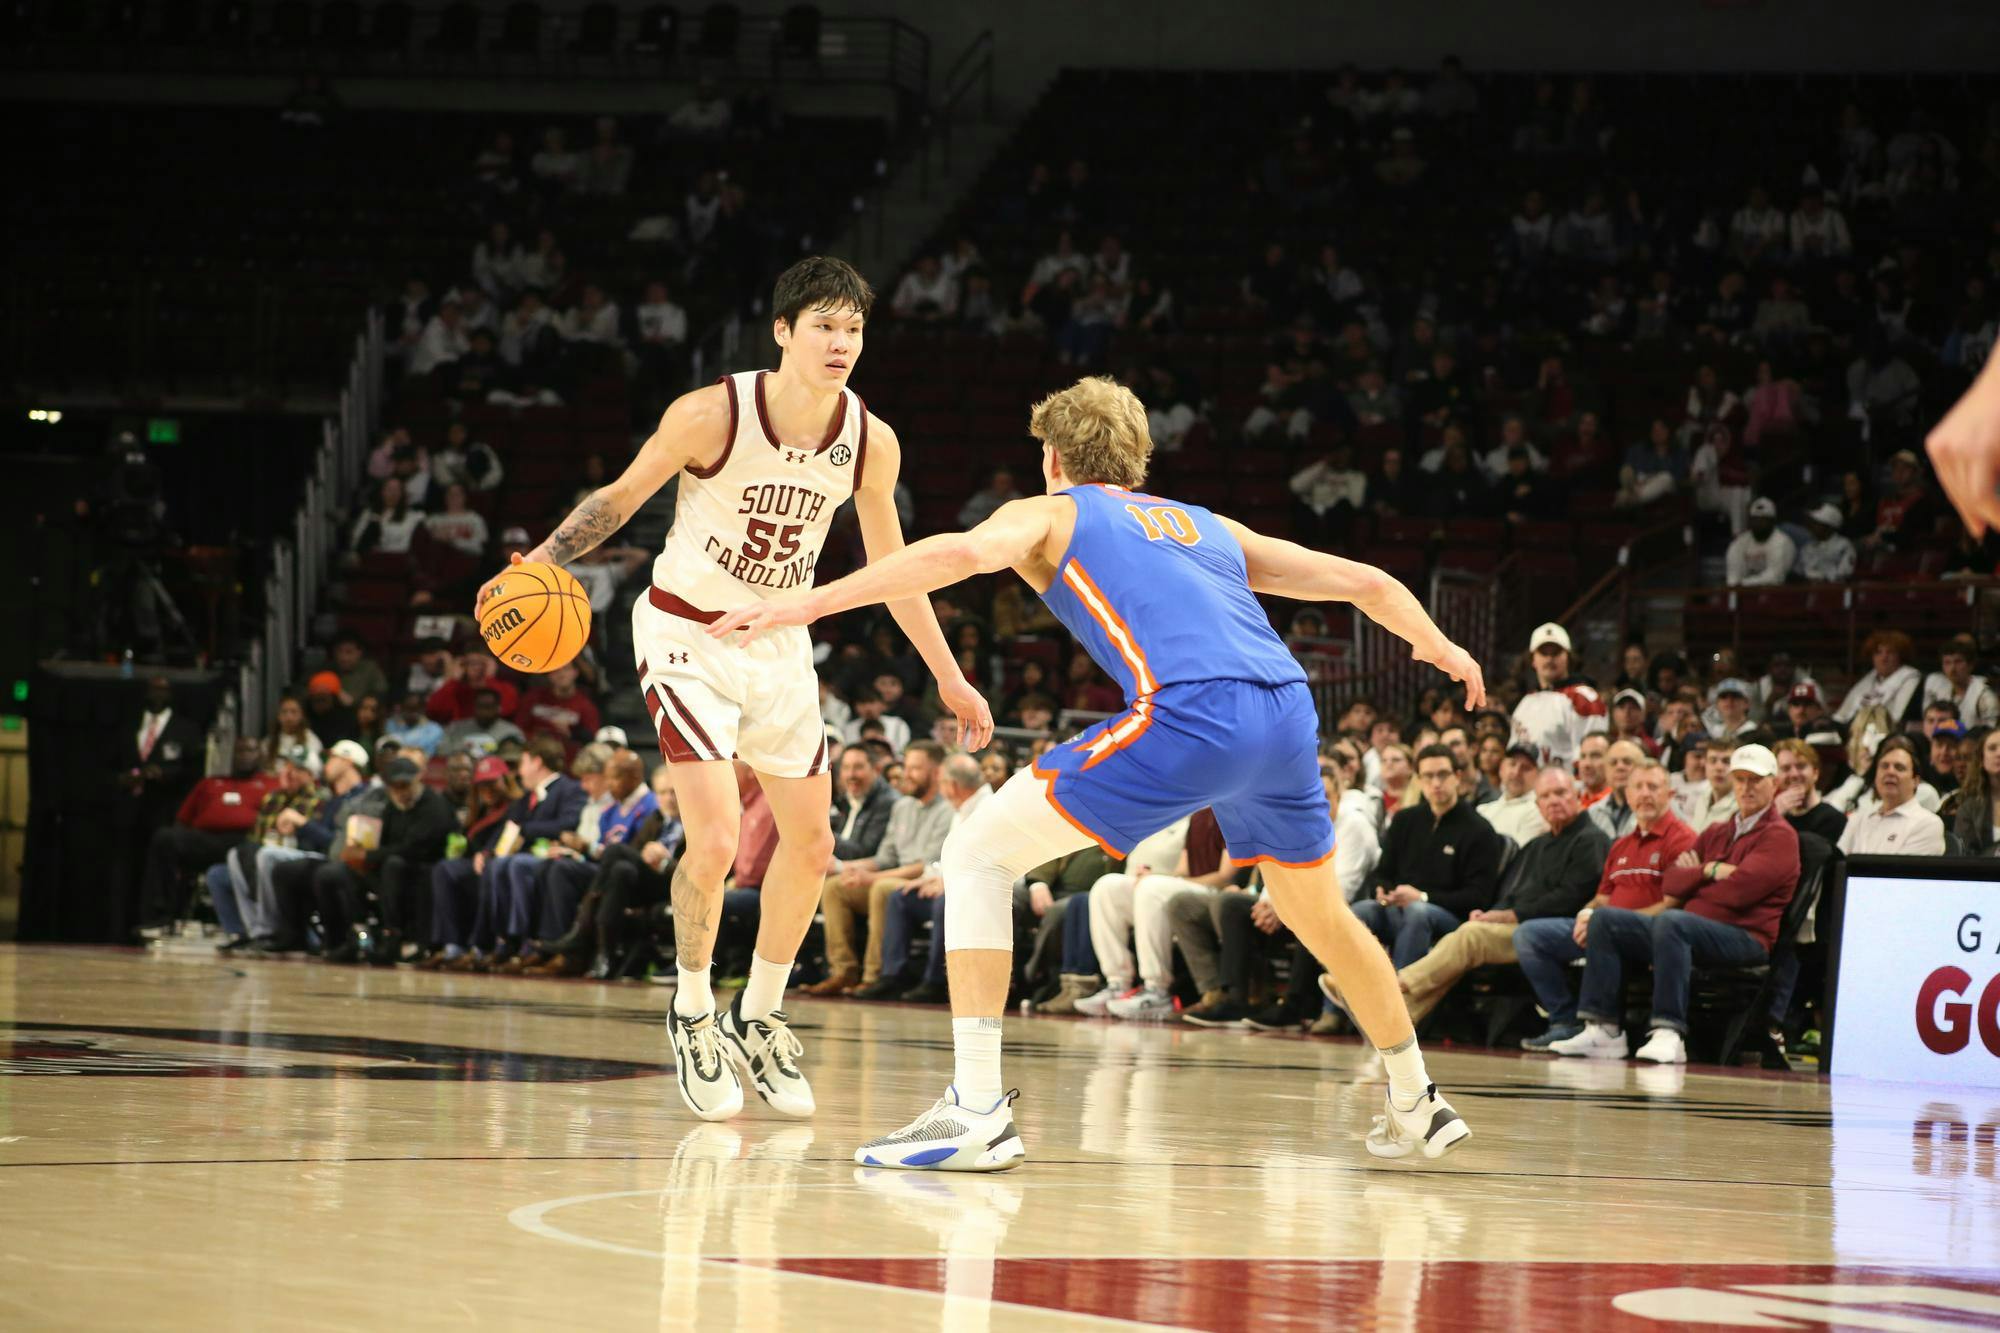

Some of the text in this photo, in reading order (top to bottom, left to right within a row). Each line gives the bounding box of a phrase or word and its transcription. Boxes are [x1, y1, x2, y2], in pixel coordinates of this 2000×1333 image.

[831, 445, 851, 465] SEC
[738, 484, 827, 522] SOUTH
[741, 517, 805, 563] 55
[1124, 504, 1202, 546] 10
[1957, 912, 2000, 955] G
